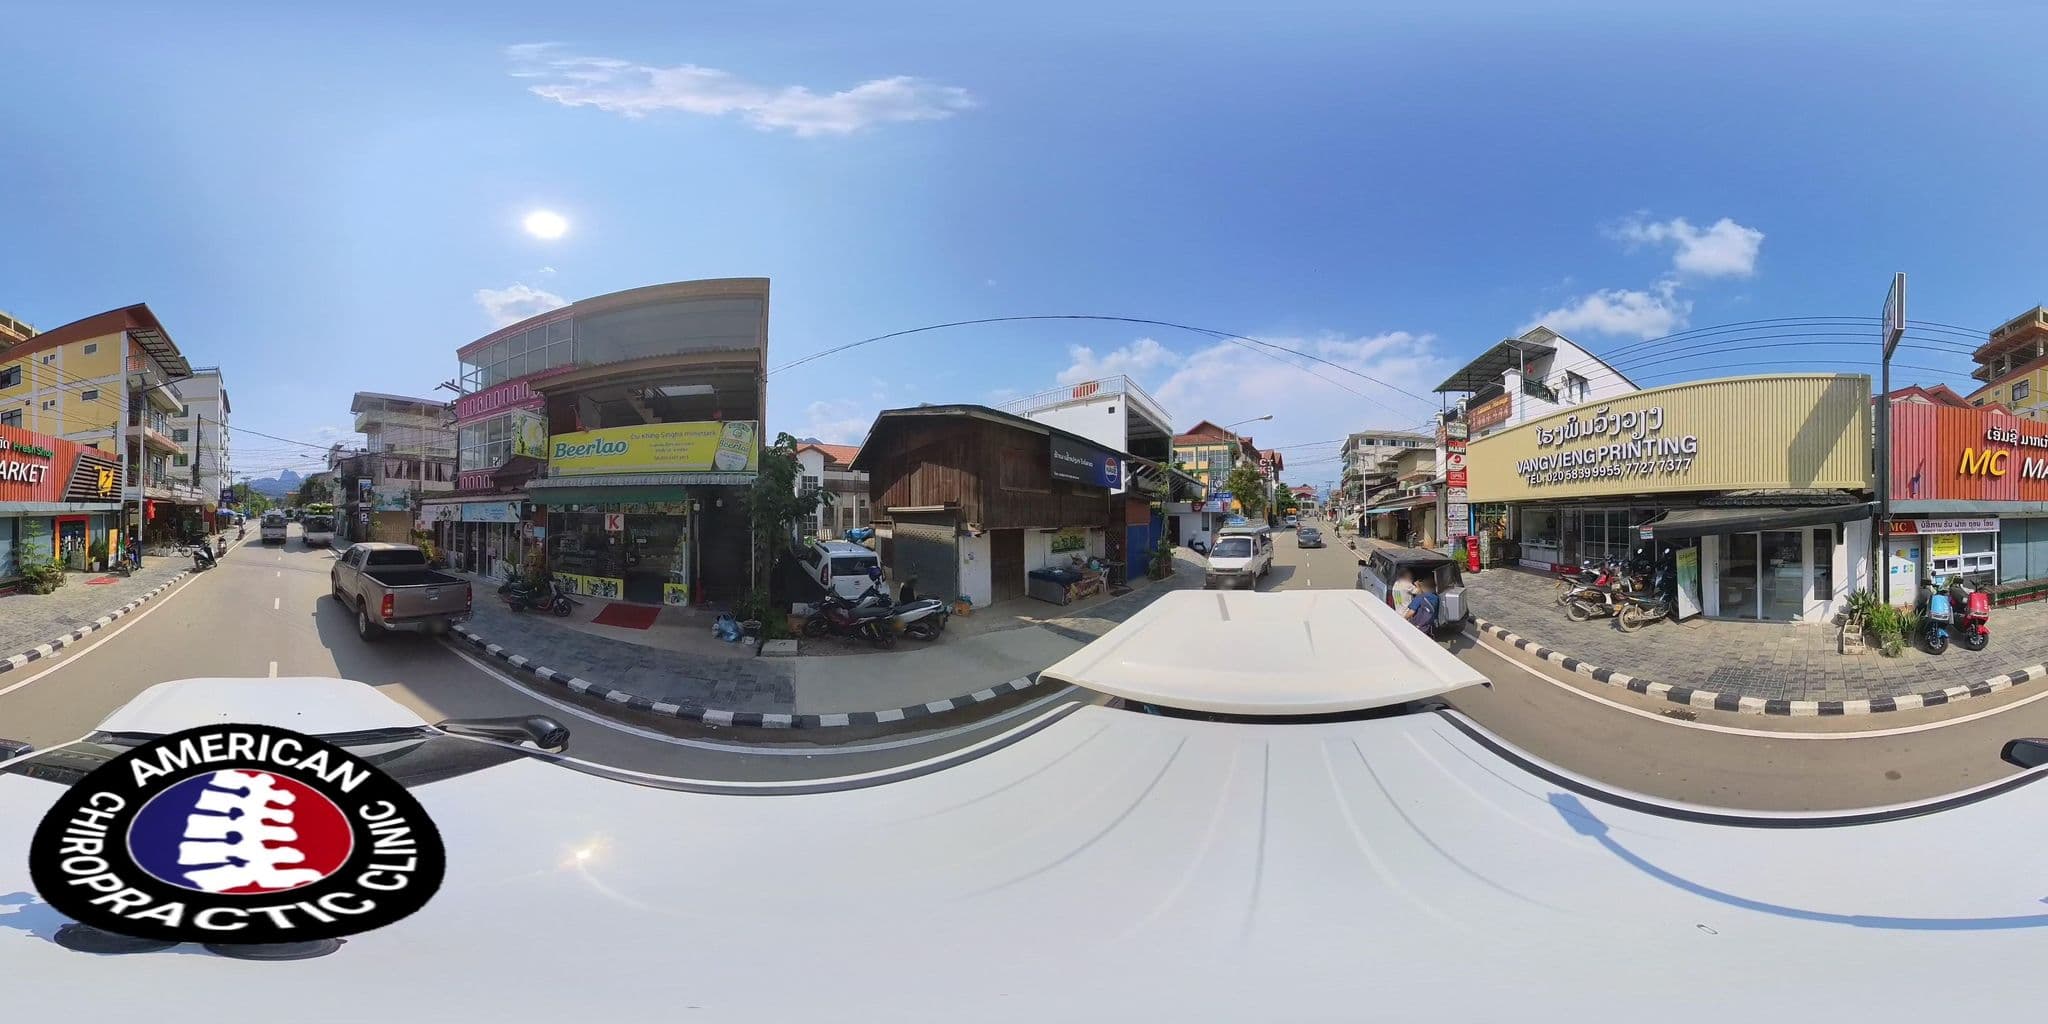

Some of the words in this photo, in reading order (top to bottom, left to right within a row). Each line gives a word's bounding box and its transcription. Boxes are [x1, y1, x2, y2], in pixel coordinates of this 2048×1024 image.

[13, 443, 36, 455] Fresh
[36, 446, 54, 458] Shop
[554, 437, 629, 458] Beerlao
[1448, 445, 1466, 453] MART
[1516, 448, 1596, 474] VANGVIENG
[1598, 435, 1697, 464] PRINTING
[1547, 470, 1564, 482] 020
[1565, 467, 1591, 480] 5839
[1592, 463, 1626, 478] 9955,
[1626, 461, 1656, 475] 7727
[1658, 458, 1692, 472] 7377
[1960, 447, 2009, 476] MC
[607, 514, 620, 529] K
[1889, 521, 1908, 532] MC
